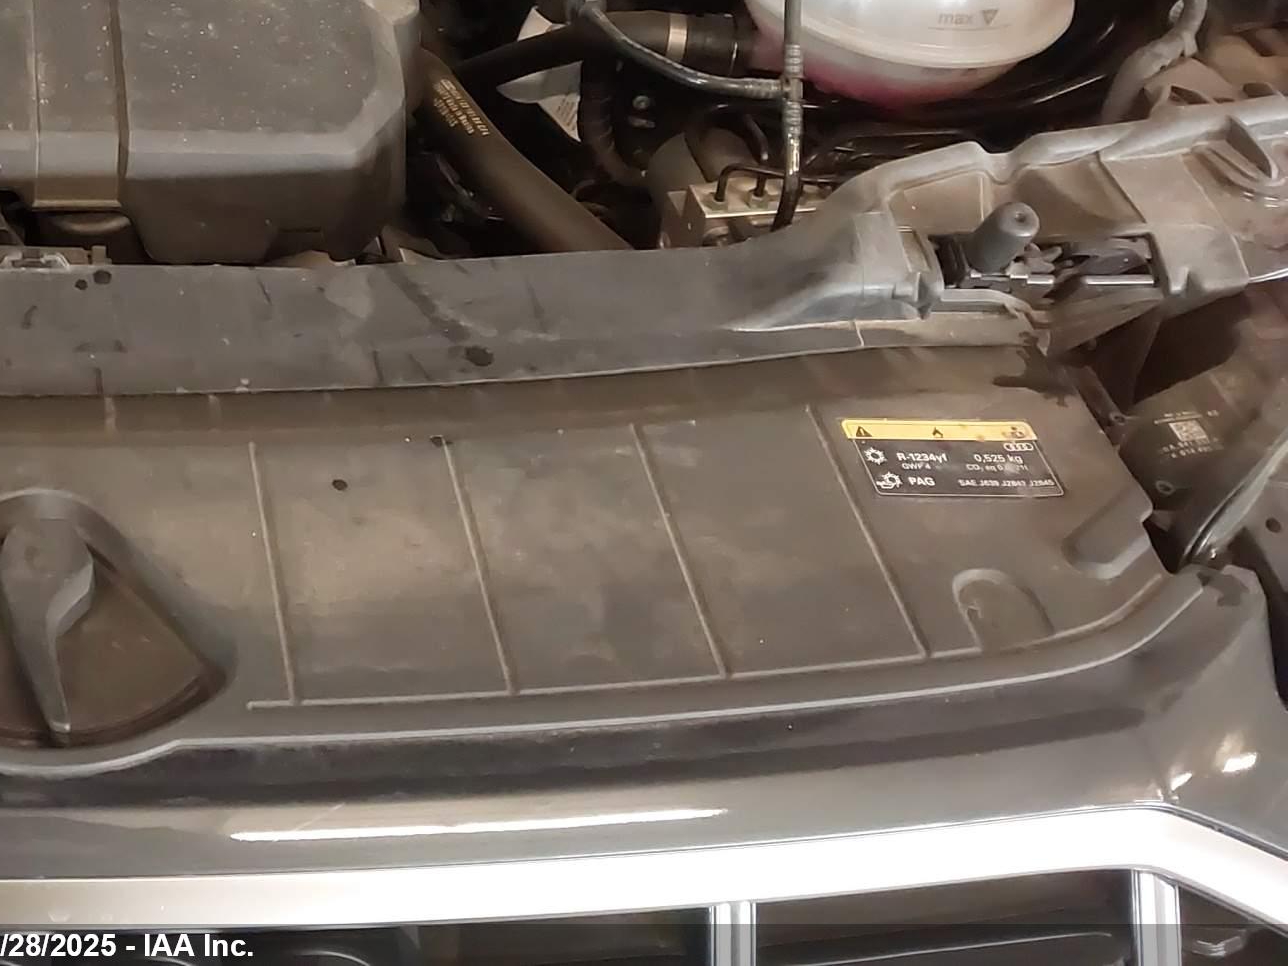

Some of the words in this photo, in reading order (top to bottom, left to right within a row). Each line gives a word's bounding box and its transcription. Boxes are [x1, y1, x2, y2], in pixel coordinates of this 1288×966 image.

[937, 12, 973, 26] max
[896, 452, 948, 464] R-1234yf
[974, 454, 1006, 464] 0,525
[1008, 454, 1024, 465] kg
[908, 476, 936, 487] PAG
[957, 479, 977, 487] SAE
